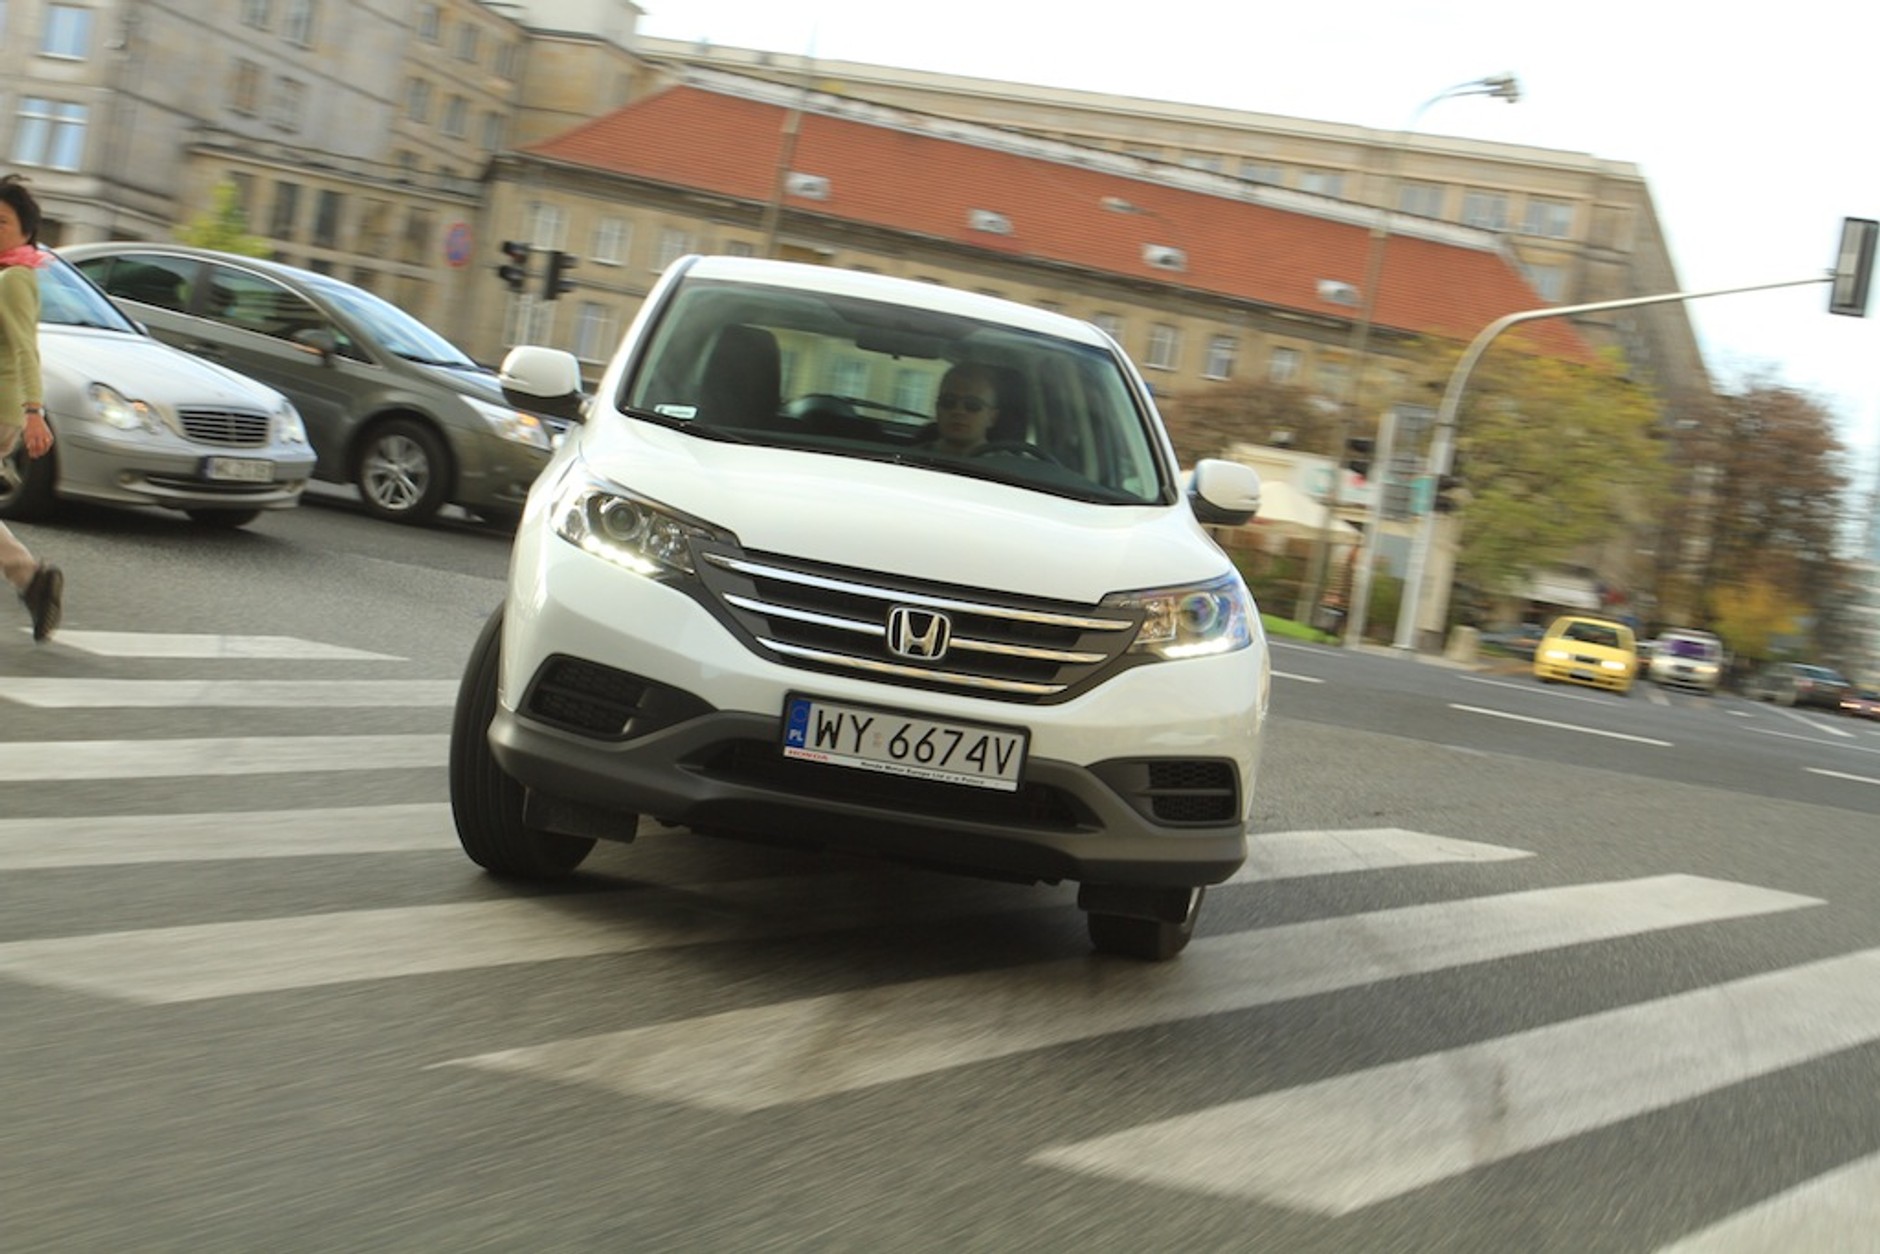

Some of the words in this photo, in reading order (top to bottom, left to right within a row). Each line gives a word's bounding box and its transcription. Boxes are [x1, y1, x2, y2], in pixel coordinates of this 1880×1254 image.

[788, 728, 804, 742] PL
[815, 709, 875, 753] WY
[888, 722, 1017, 775] 6674V
